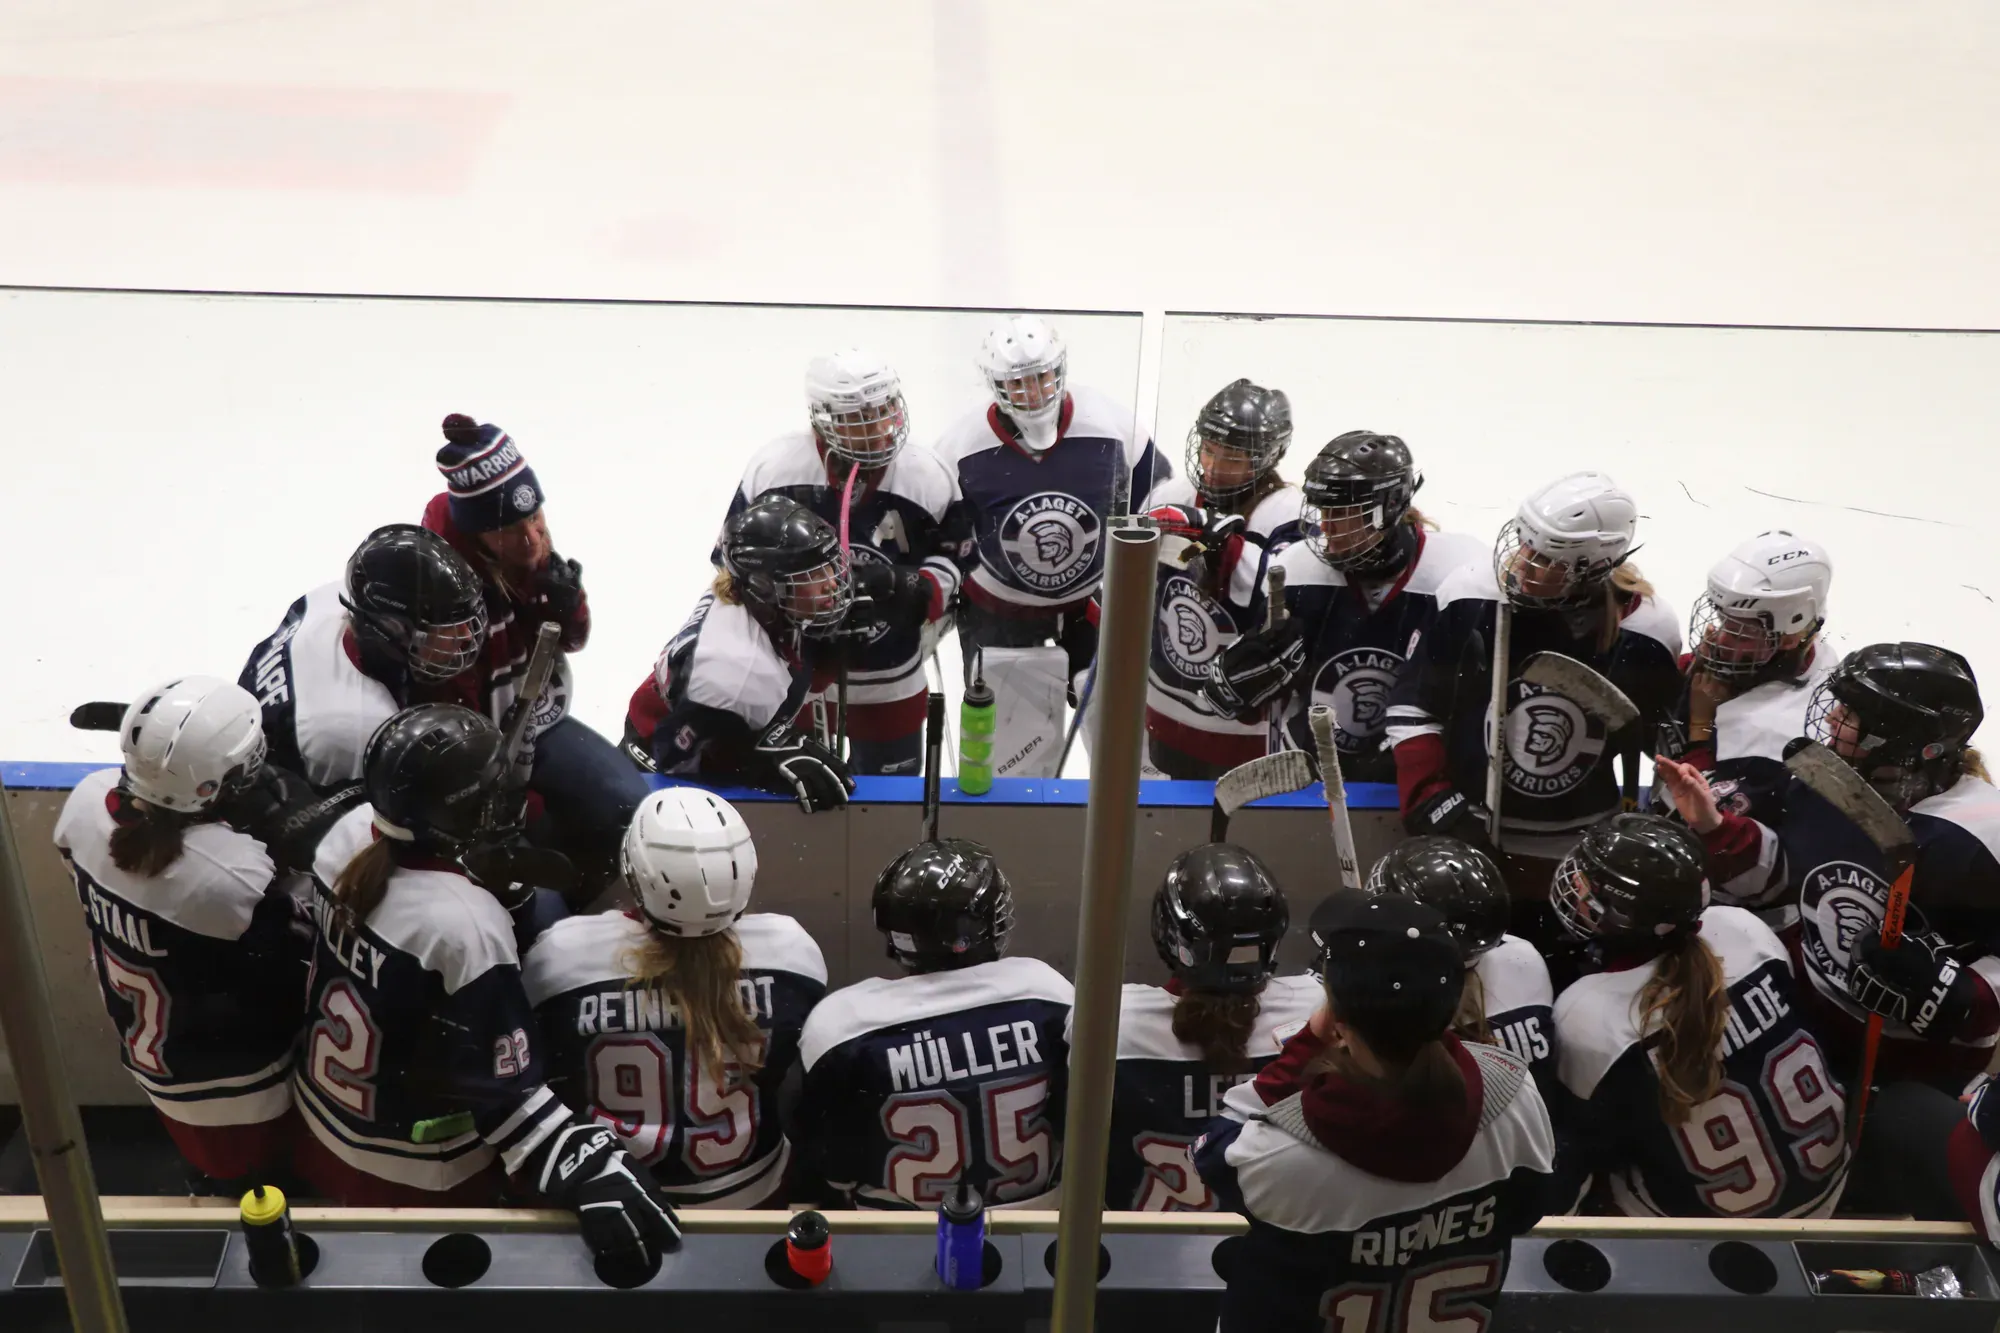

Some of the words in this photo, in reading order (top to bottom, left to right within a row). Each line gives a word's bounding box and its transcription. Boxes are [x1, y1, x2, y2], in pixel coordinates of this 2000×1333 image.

[863, 382, 889, 396] CCM
[1014, 497, 1087, 525] A-LAGET
[1015, 552, 1092, 587] WARRIORS
[1767, 550, 1810, 566] CCM
[1162, 636, 1212, 676] WARRIO
[1335, 653, 1395, 677] A-LAG
[997, 735, 1044, 775] BAUER
[1502, 760, 1582, 792] ARRIORS
[1428, 791, 1466, 825] BAU
[936, 853, 965, 890] CCM
[1603, 883, 1637, 901] CCM
[1816, 867, 1890, 904] A-LAGE
[100, 936, 174, 1079] 7
[577, 976, 775, 1037] REINHDT
[1910, 955, 1961, 1034] ASTON
[1492, 1016, 1550, 1063] UIS
[1715, 974, 1791, 1062] ILDE
[308, 977, 383, 1124] 2
[494, 1027, 532, 1079] 22
[887, 1019, 1044, 1092] MÜLLER
[585, 1028, 772, 1177] 95
[1183, 1073, 1257, 1119] LE
[880, 1072, 1052, 1204] 25
[1668, 1028, 1847, 1217] 99
[558, 1128, 618, 1182] EAST
